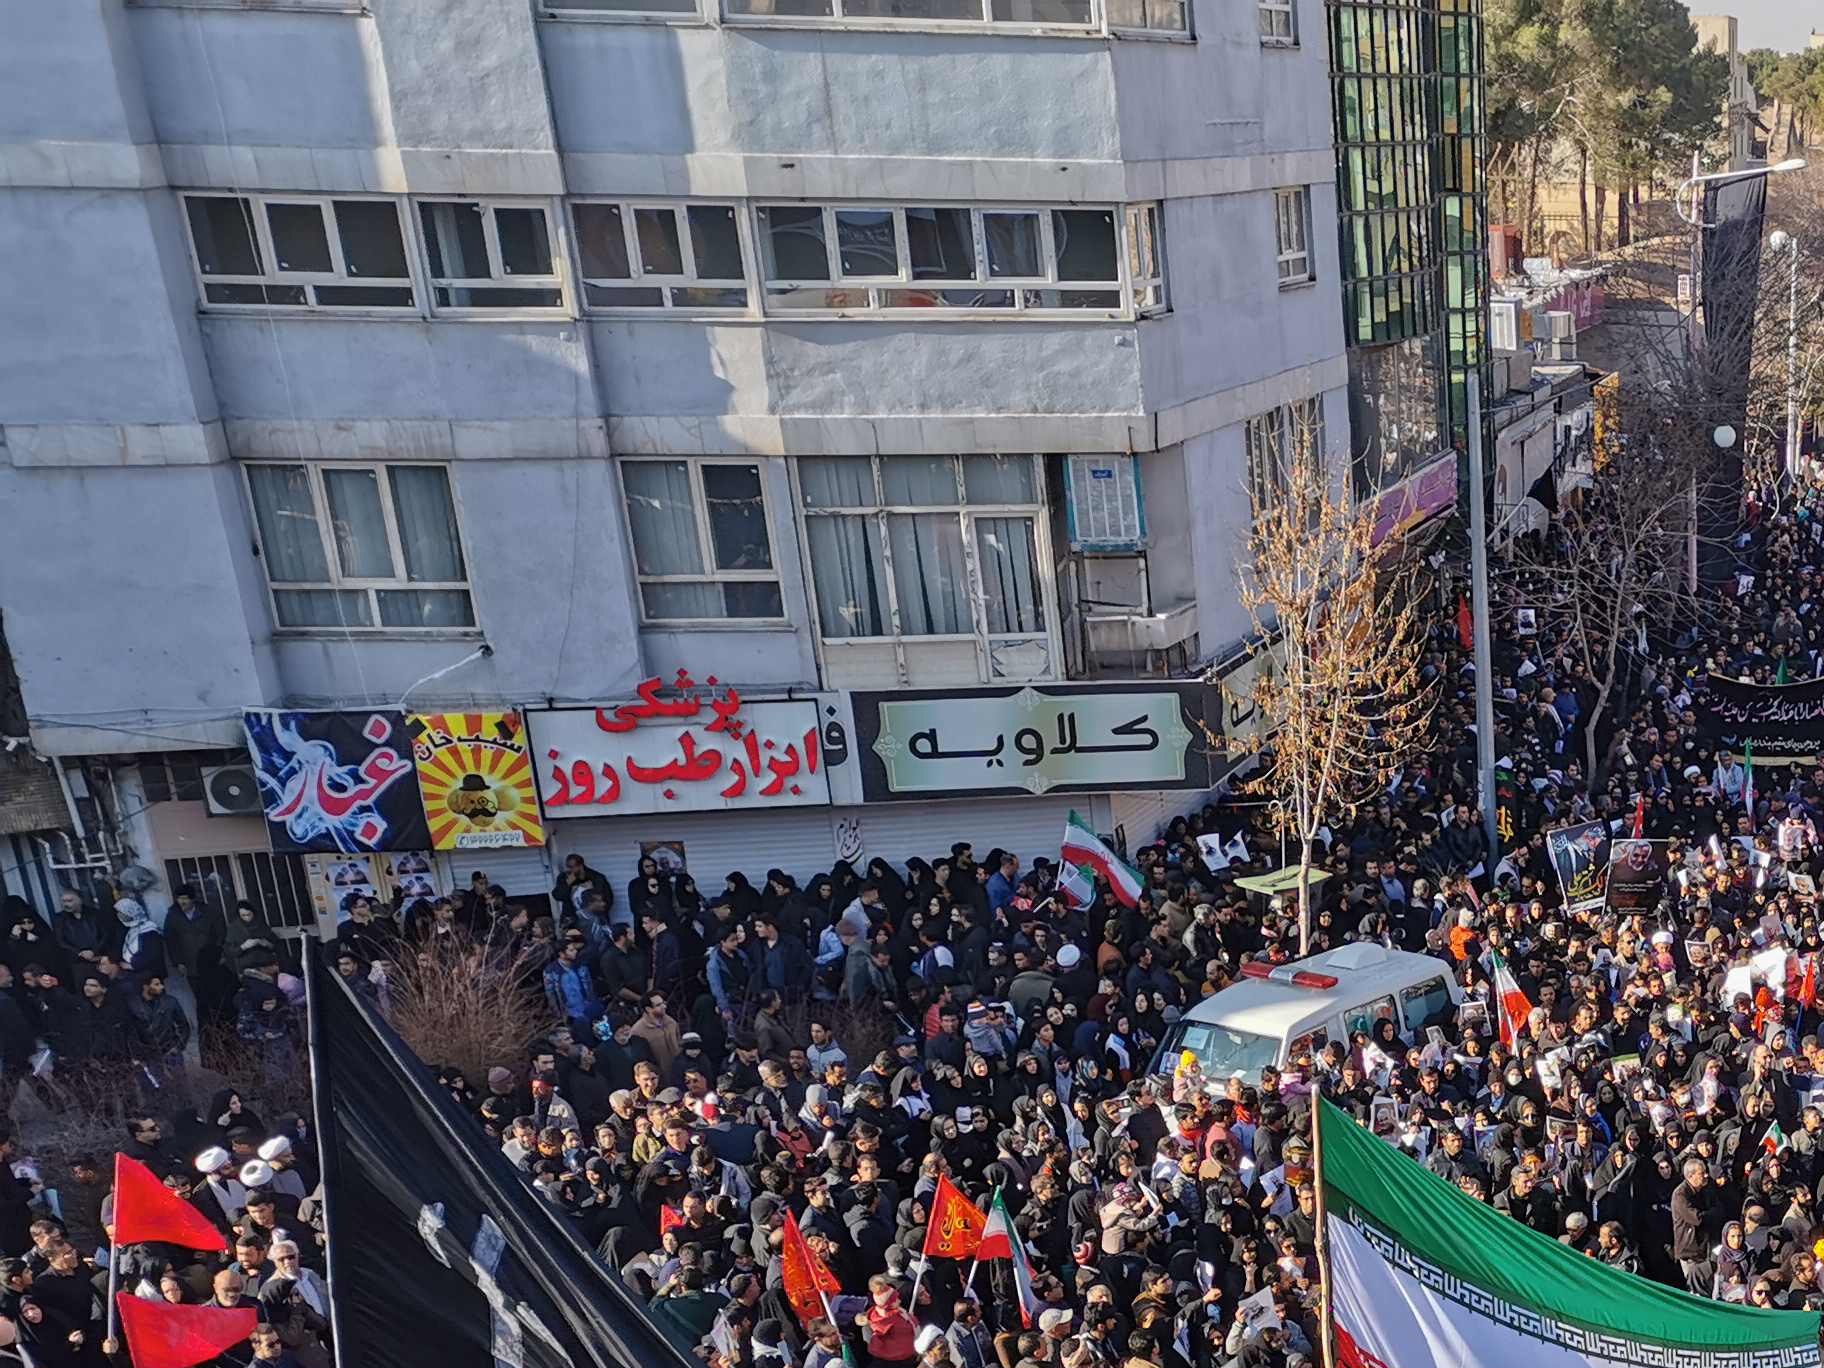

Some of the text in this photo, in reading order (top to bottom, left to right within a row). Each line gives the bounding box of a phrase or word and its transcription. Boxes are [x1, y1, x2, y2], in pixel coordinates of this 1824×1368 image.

[595, 667, 744, 741] پزشکی
[626, 730, 723, 800] طب
[720, 726, 818, 798] ابزار
[908, 711, 1160, 768] کلاویه
[543, 748, 621, 807] روز
